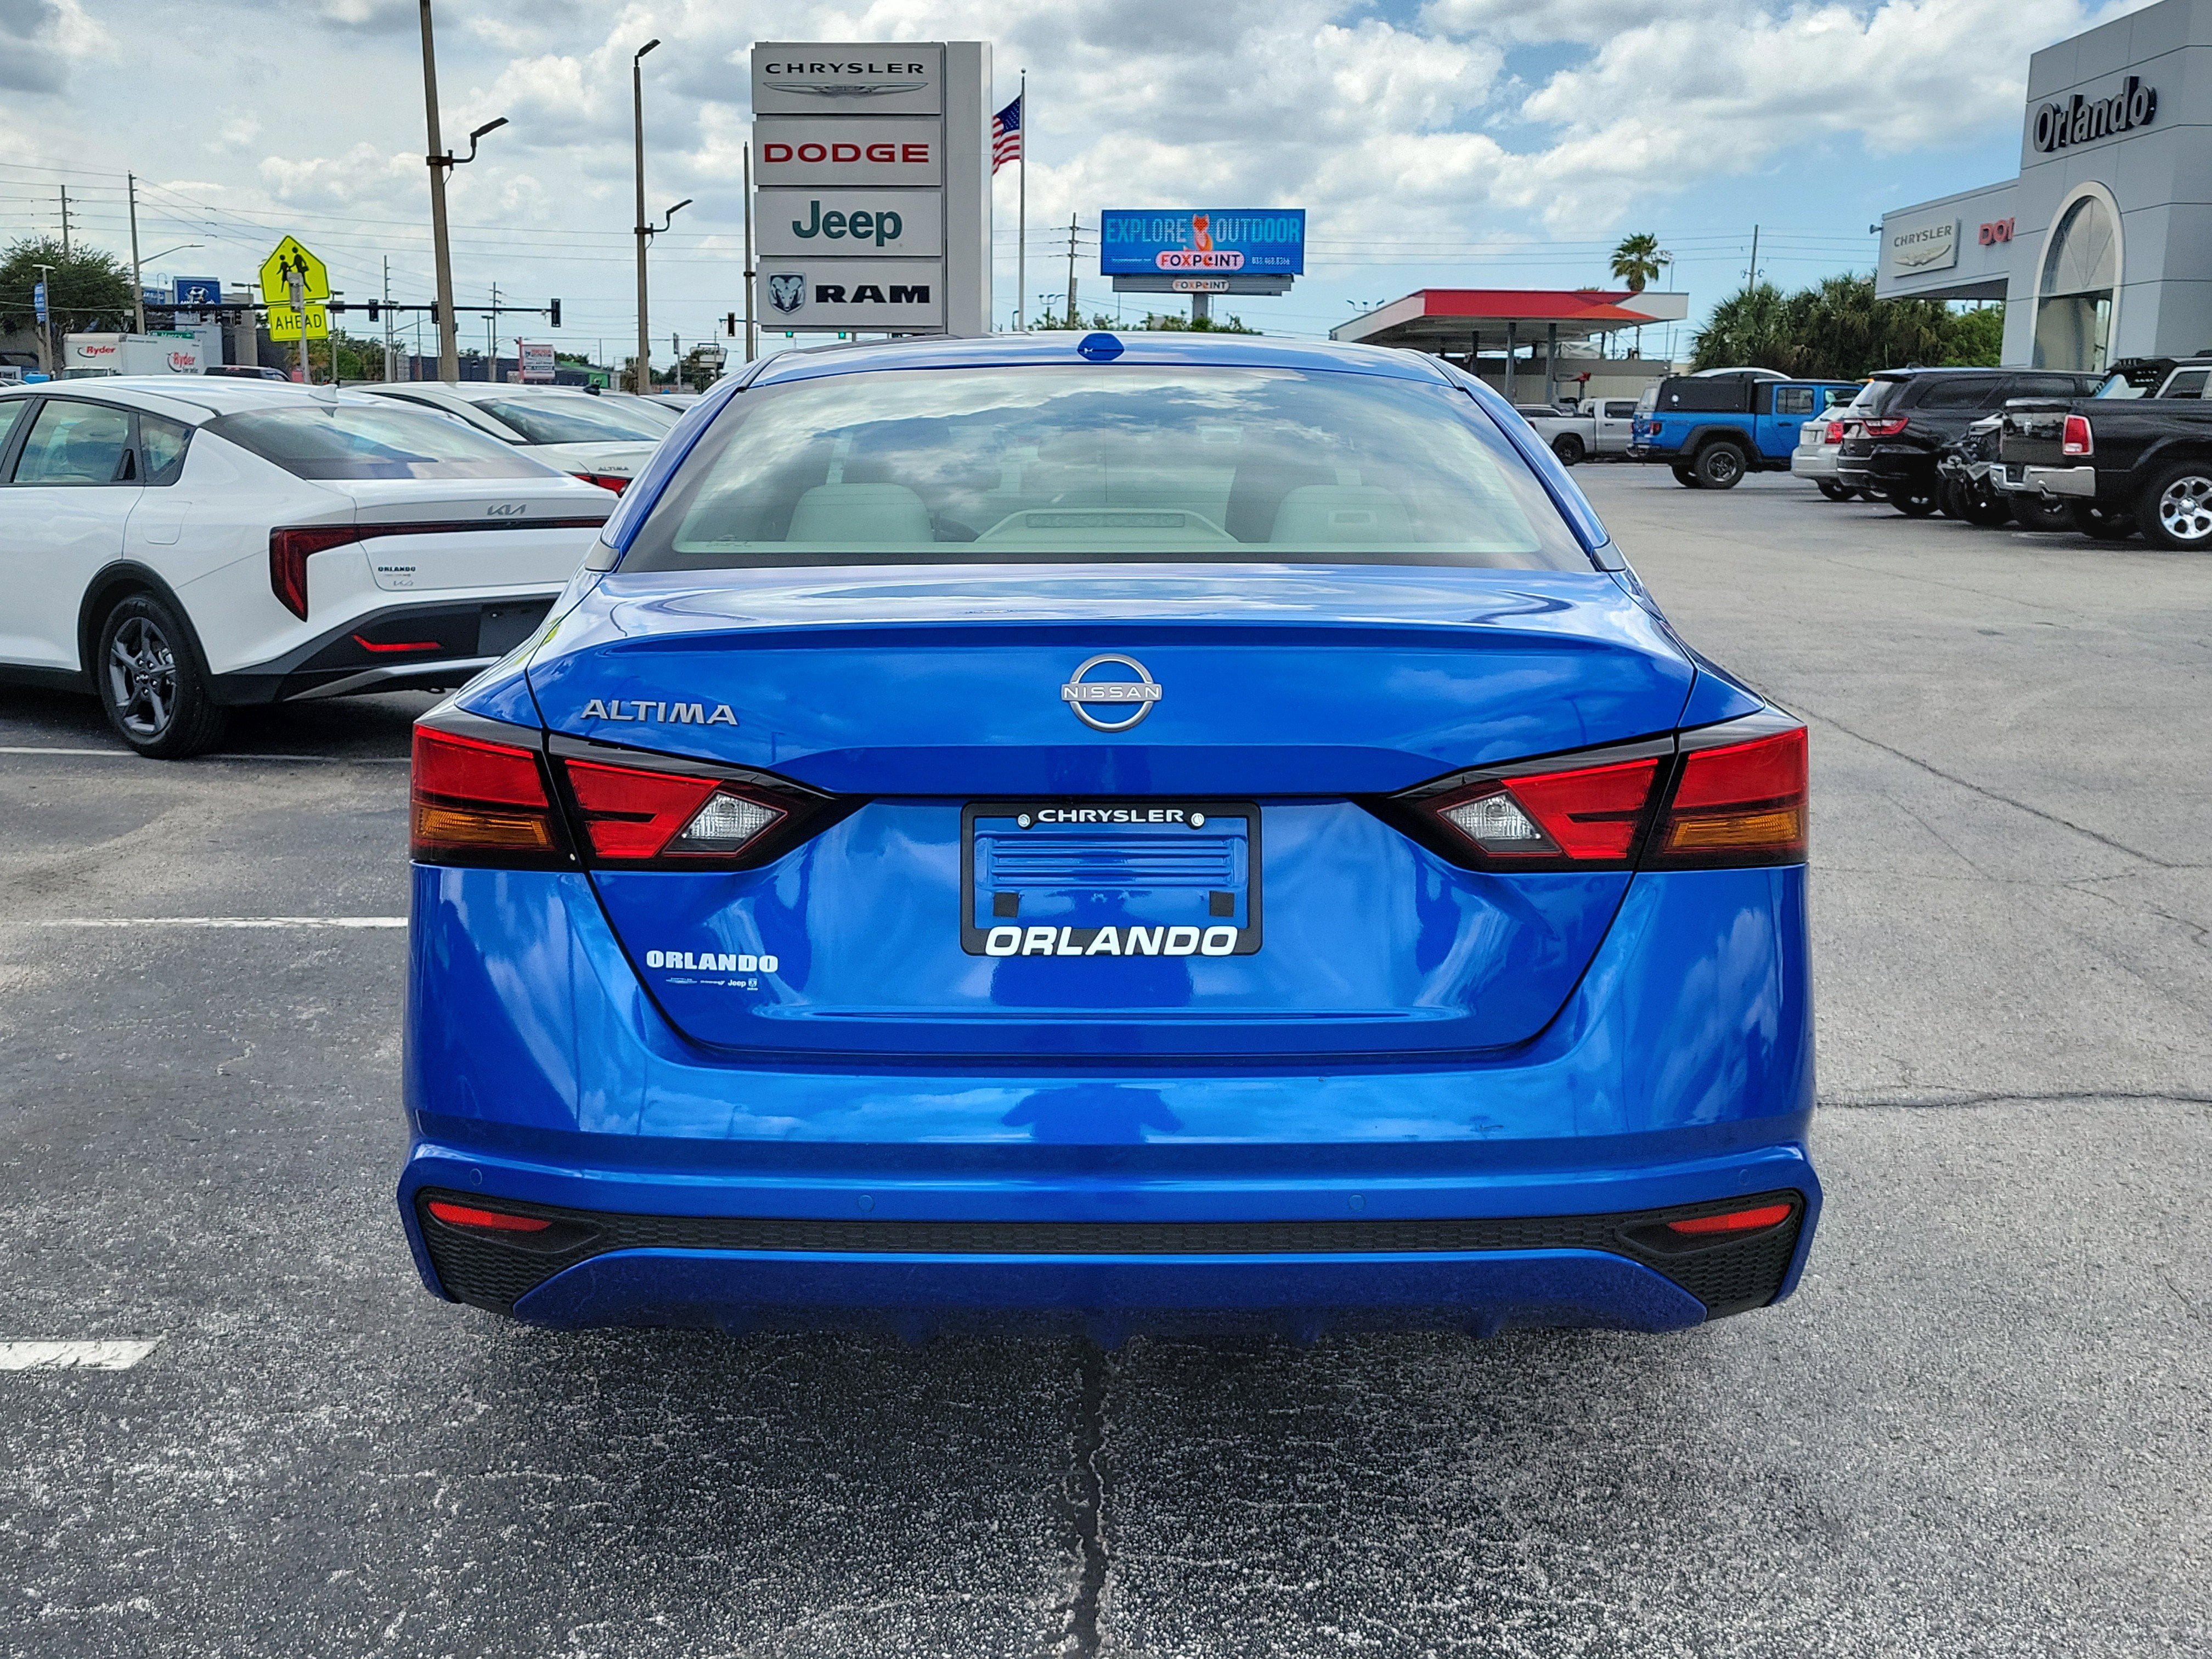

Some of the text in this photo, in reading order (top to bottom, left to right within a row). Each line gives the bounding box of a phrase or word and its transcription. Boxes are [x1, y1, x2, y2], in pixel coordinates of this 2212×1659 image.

[765, 63, 924, 74] CHRYSLER
[2033, 75, 2157, 153] Orlando
[764, 144, 929, 162] DODGE
[792, 200, 902, 247] Jeep
[1105, 218, 1300, 242] EXPLORE OUTDOOR
[1894, 225, 1952, 247] CHRYSLER
[1161, 254, 1240, 267] FOXPOINT
[1175, 281, 1226, 289] FOXPOINT
[815, 285, 930, 303] RAM
[276, 314, 322, 330] AHEAD
[86, 346, 116, 355] Ryder
[173, 352, 196, 367] Ryder
[1064, 686, 1159, 698] NISSAN
[580, 698, 738, 726] ALTIMA
[1037, 809, 1184, 822] CHRYSLER
[985, 926, 1238, 956] ORLANDO
[646, 950, 778, 973] ORLANDO
[727, 979, 747, 988] Jeep
